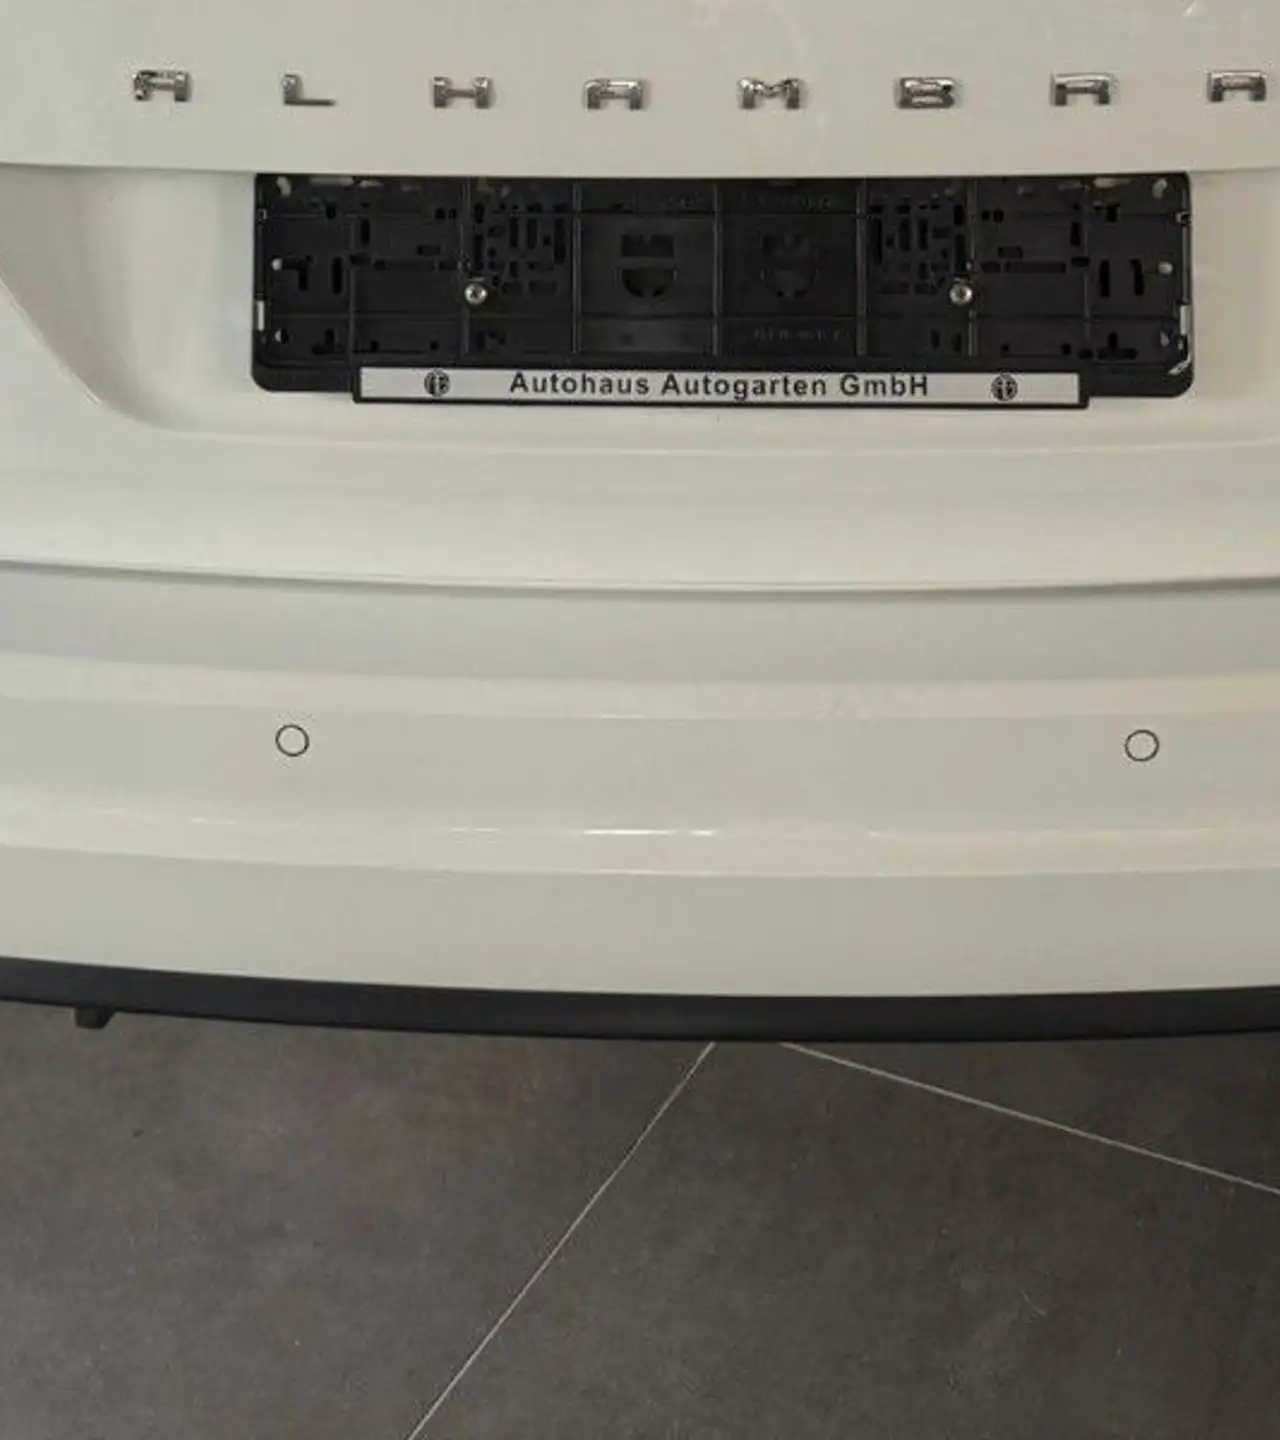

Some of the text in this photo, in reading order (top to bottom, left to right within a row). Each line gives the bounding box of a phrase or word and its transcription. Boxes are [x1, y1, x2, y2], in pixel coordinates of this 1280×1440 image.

[133, 68, 1268, 110] ALHAMBRA
[510, 371, 929, 402] Autohaus Autogarten GmbH
